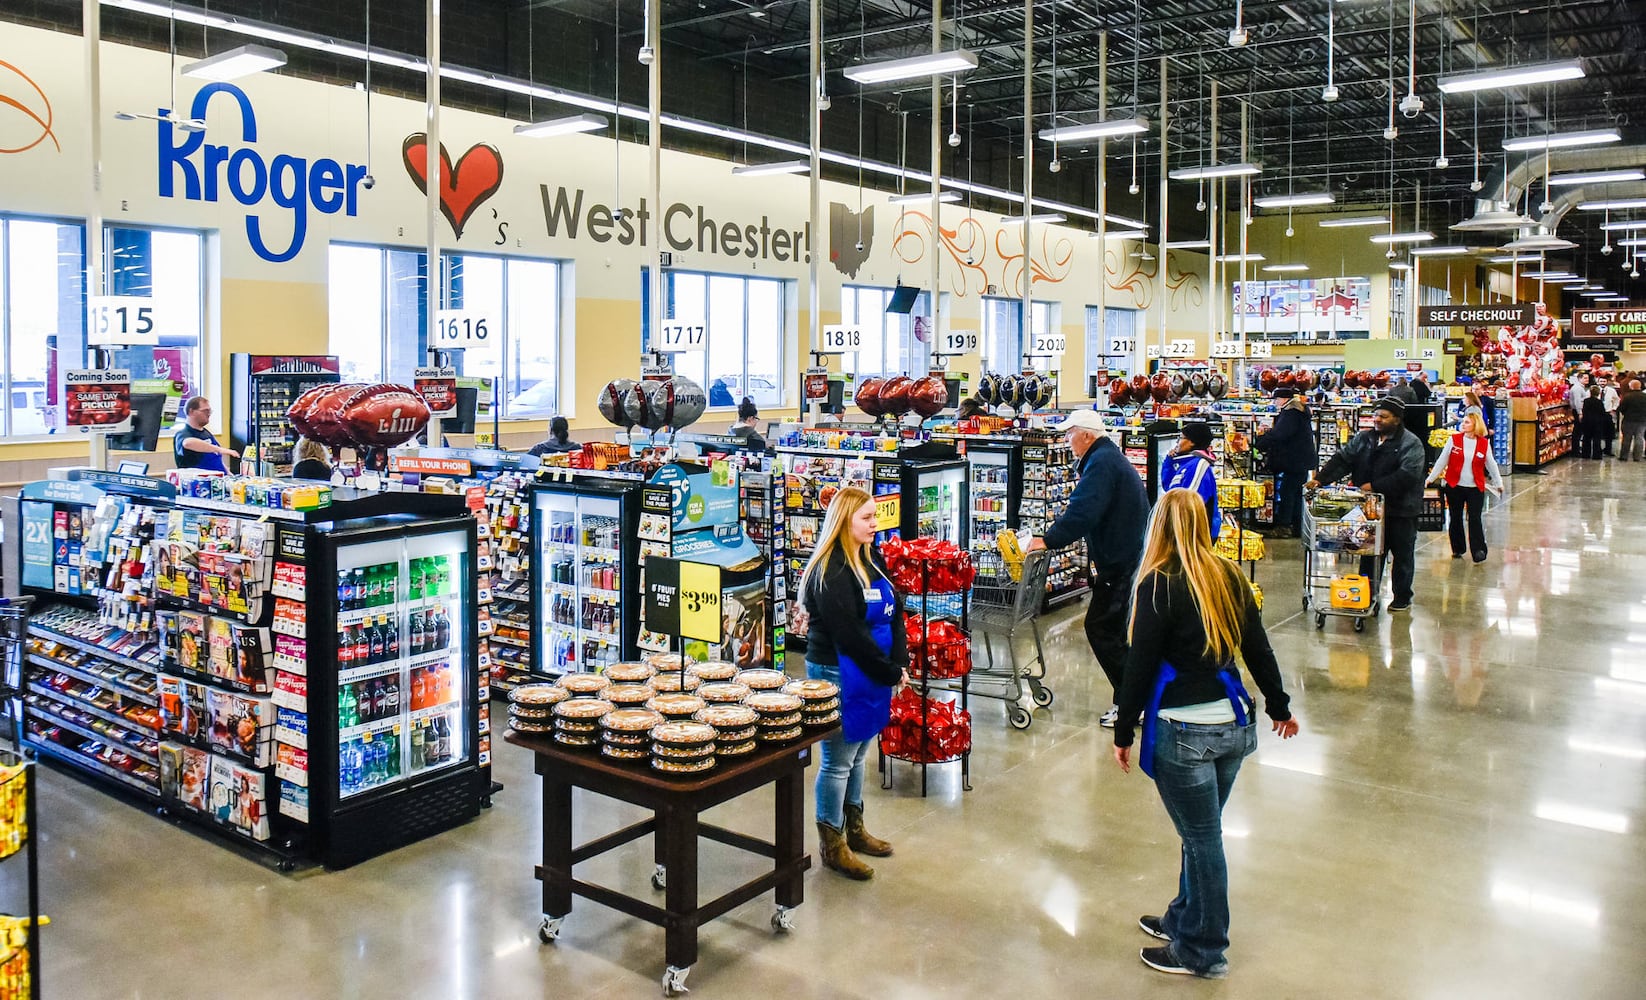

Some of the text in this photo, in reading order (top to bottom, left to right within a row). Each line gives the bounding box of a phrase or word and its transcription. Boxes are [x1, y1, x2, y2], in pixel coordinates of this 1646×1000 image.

[158, 82, 367, 263] Kroger
[540, 184, 649, 246] West
[664, 202, 810, 264] Chester!
[92, 306, 153, 334] 15 15
[1430, 310, 1523, 321] SELF CHECKOUT
[1581, 312, 1646, 323] GUEST CARE
[438, 318, 488, 340] 16 16
[1609, 324, 1646, 334] MONEY
[664, 326, 704, 344] 17 17
[826, 330, 860, 346] 18 18
[947, 334, 976, 349] 19 19
[1038, 338, 1064, 351] 20 20
[1113, 340, 1127, 351] 21
[1173, 344, 1188, 353] 22
[1253, 345, 1265, 354] 24
[66, 372, 127, 382] Coming Soon
[643, 367, 660, 376] Coming
[399, 460, 468, 471] REFILL YOUR PHONE
[656, 478, 689, 507] 5¢
[882, 502, 895, 516] $10
[26, 520, 48, 544] 2X
[275, 566, 290, 576] happy
[658, 585, 676, 595] FRUIT
[657, 593, 670, 602] PIES
